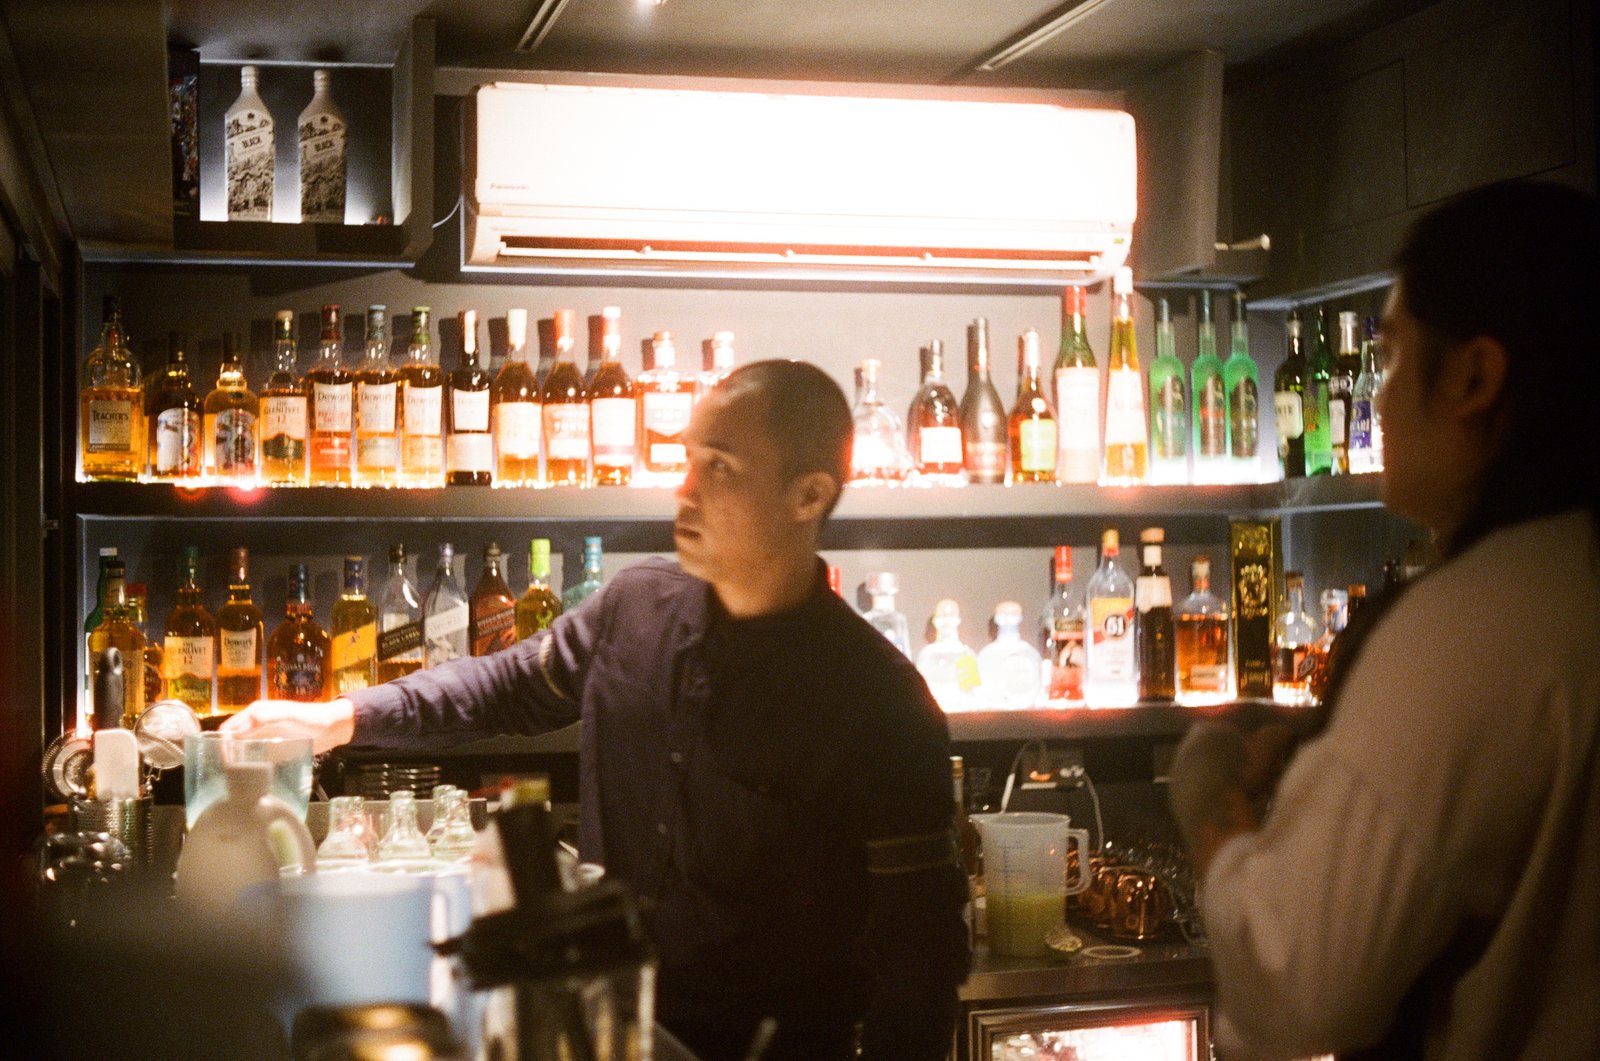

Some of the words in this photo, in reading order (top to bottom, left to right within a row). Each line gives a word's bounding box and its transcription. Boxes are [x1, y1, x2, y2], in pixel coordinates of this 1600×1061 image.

[242, 136, 261, 149] BLACK
[314, 140, 335, 152] BLACK
[92, 409, 129, 422] TEACHER'S
[1106, 615, 1125, 637] 61
